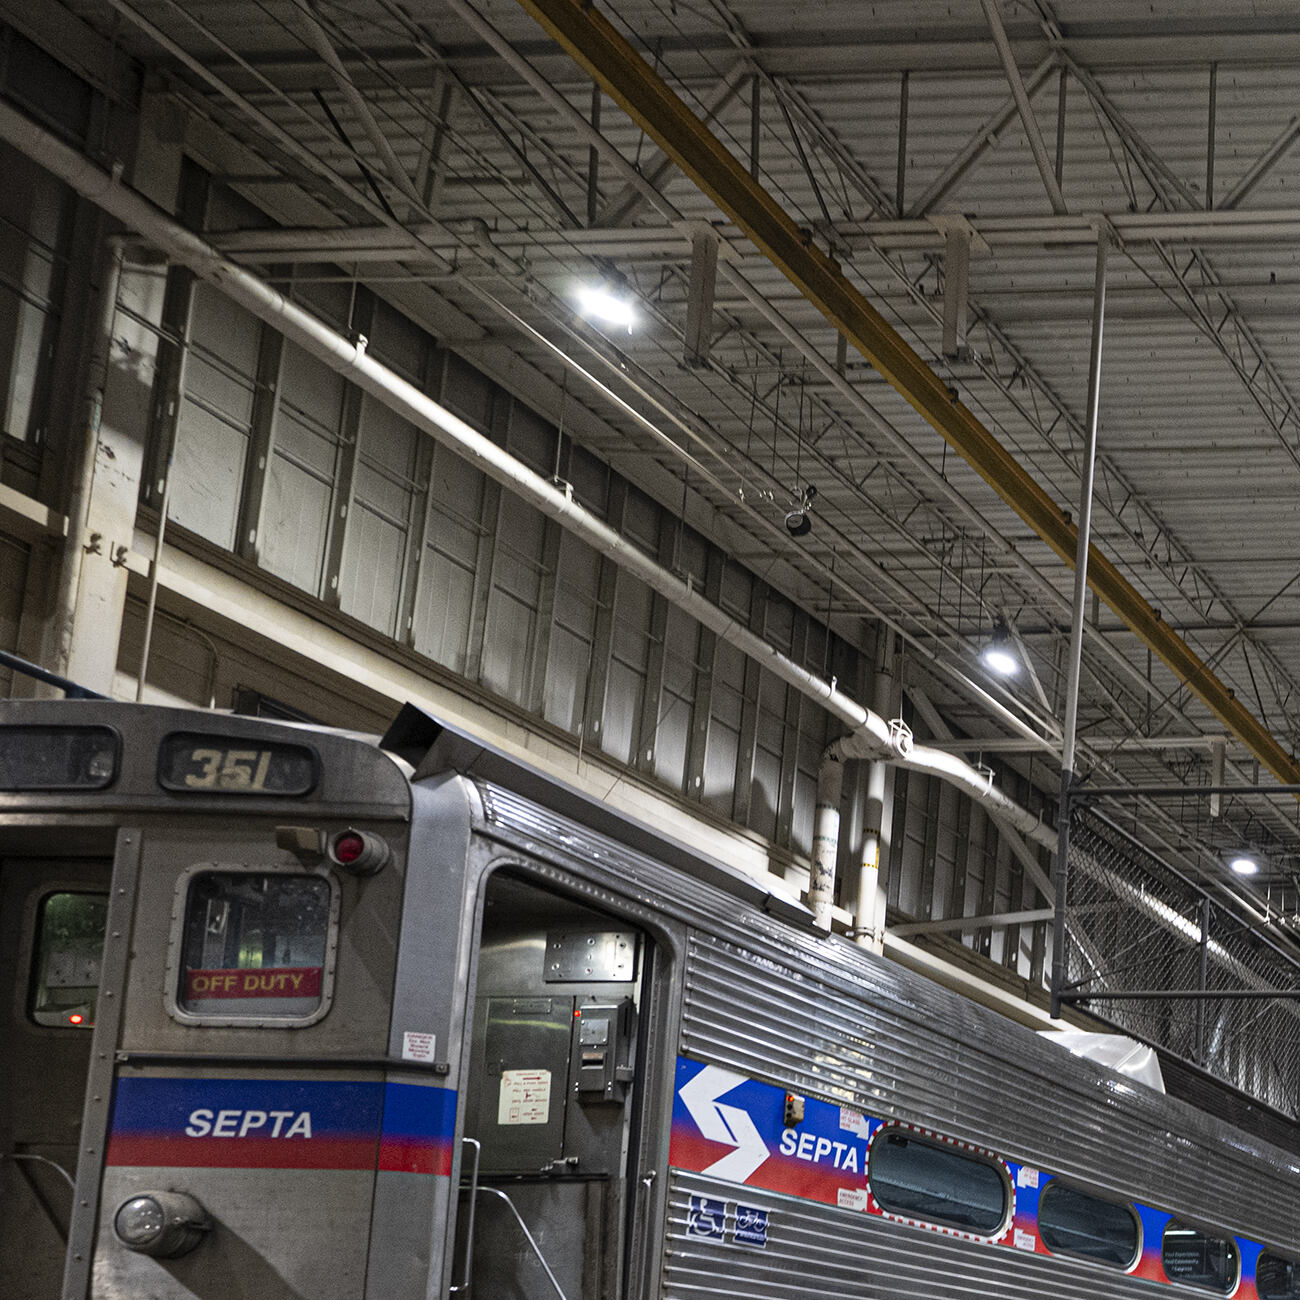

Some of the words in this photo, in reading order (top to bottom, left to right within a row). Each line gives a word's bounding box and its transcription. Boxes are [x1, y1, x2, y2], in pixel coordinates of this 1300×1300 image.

[184, 748, 272, 790] 351
[191, 974, 237, 992] OFF
[243, 974, 304, 991] DUTY
[184, 1109, 312, 1139] SEPTA
[779, 1128, 858, 1174] SEPTA
